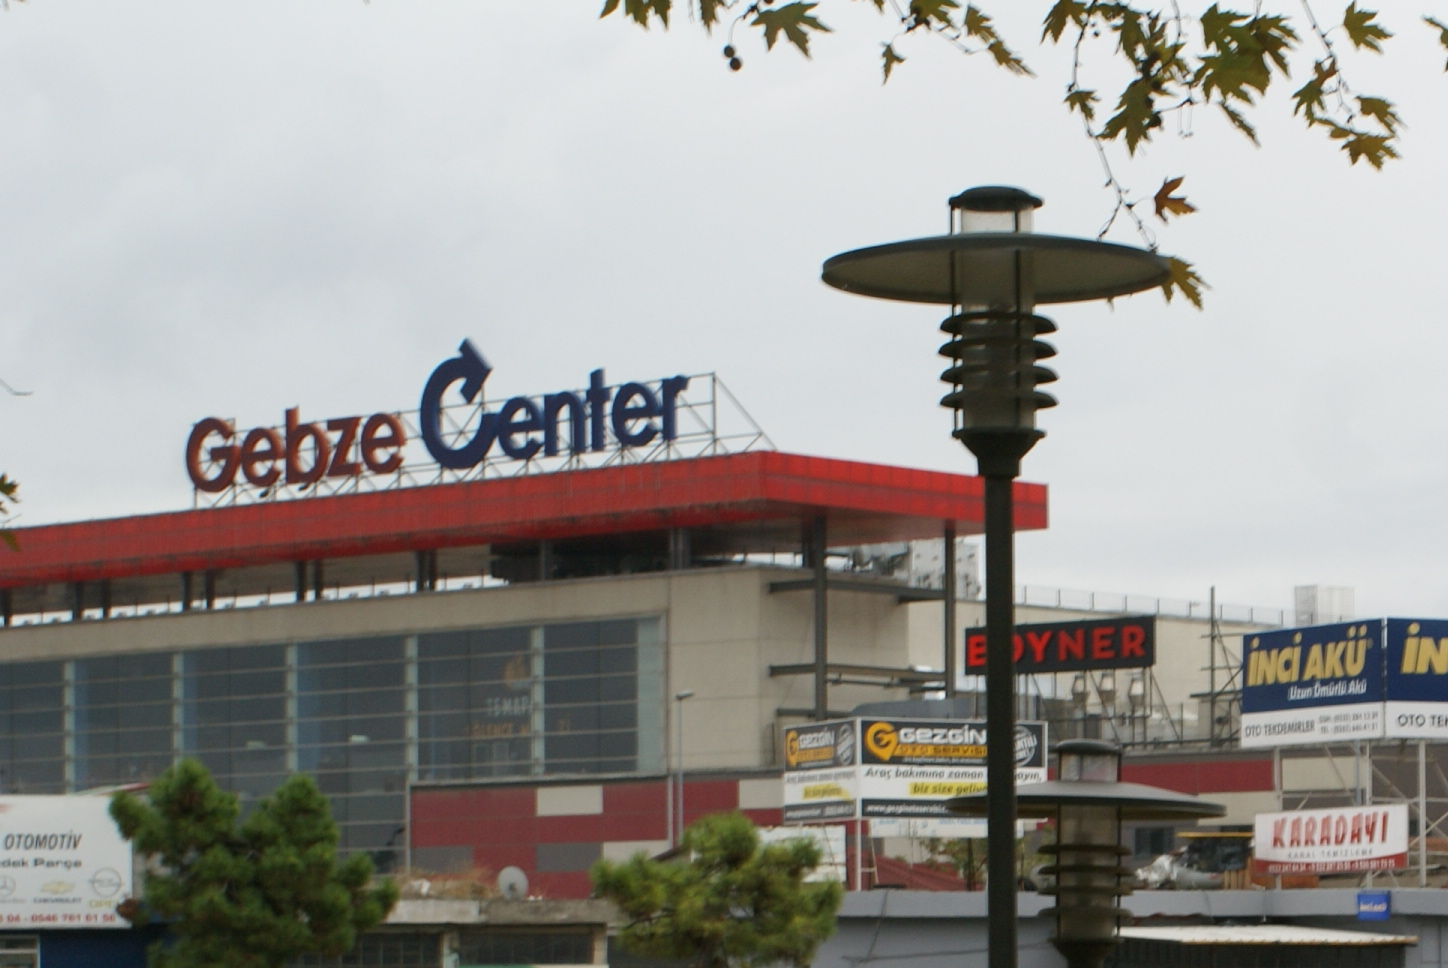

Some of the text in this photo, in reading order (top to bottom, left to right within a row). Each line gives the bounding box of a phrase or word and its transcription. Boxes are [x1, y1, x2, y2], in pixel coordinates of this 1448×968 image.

[185, 337, 690, 493] Gebze Center
[1246, 624, 1368, 687] İNCİ AKÜ
[1397, 712, 1426, 728] OTO
[913, 782, 928, 794] biz
[932, 783, 952, 794] size
[4, 829, 83, 850] OTOMOTİV
[1272, 811, 1389, 849] KARADAYI
